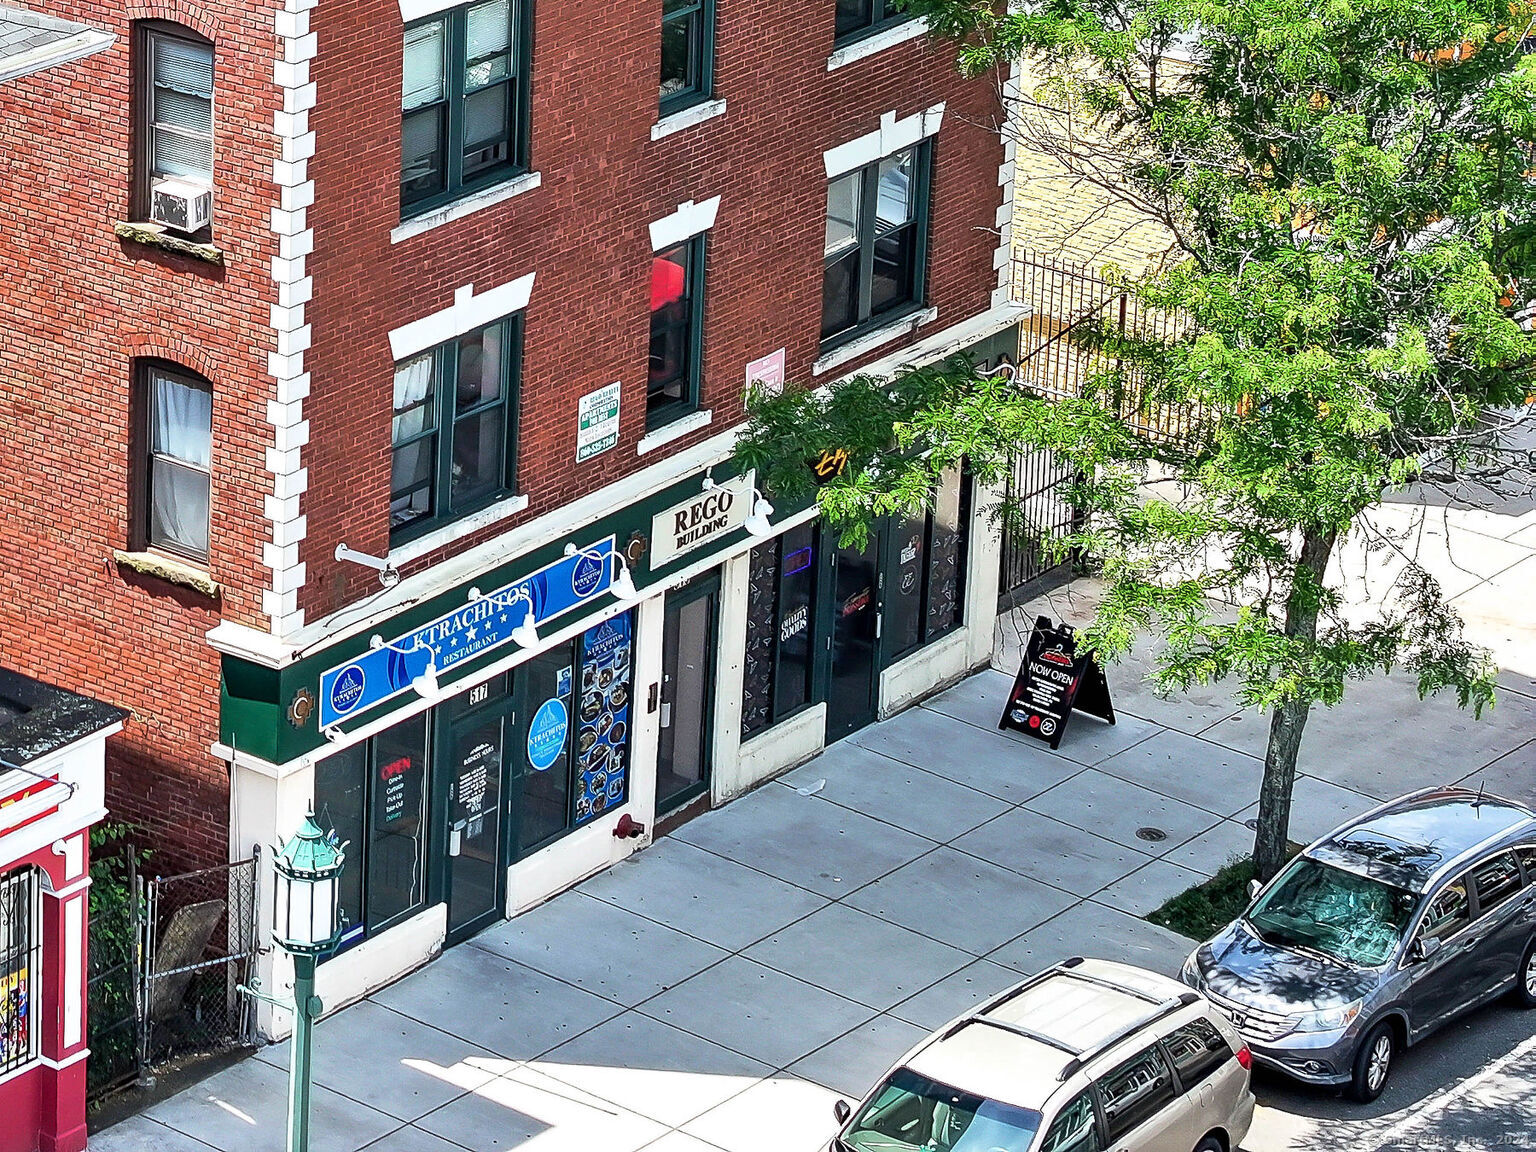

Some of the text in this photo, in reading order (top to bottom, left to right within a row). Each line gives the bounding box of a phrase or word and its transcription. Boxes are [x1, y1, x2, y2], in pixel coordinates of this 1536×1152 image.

[673, 491, 733, 536] REGO
[676, 514, 728, 549] BUILDING
[413, 582, 530, 650] KTRACHITOS
[443, 632, 498, 665] RESTAURANT
[1029, 662, 1074, 686] NOW OPEN
[469, 683, 488, 705] 517
[381, 756, 411, 780] OPEN
